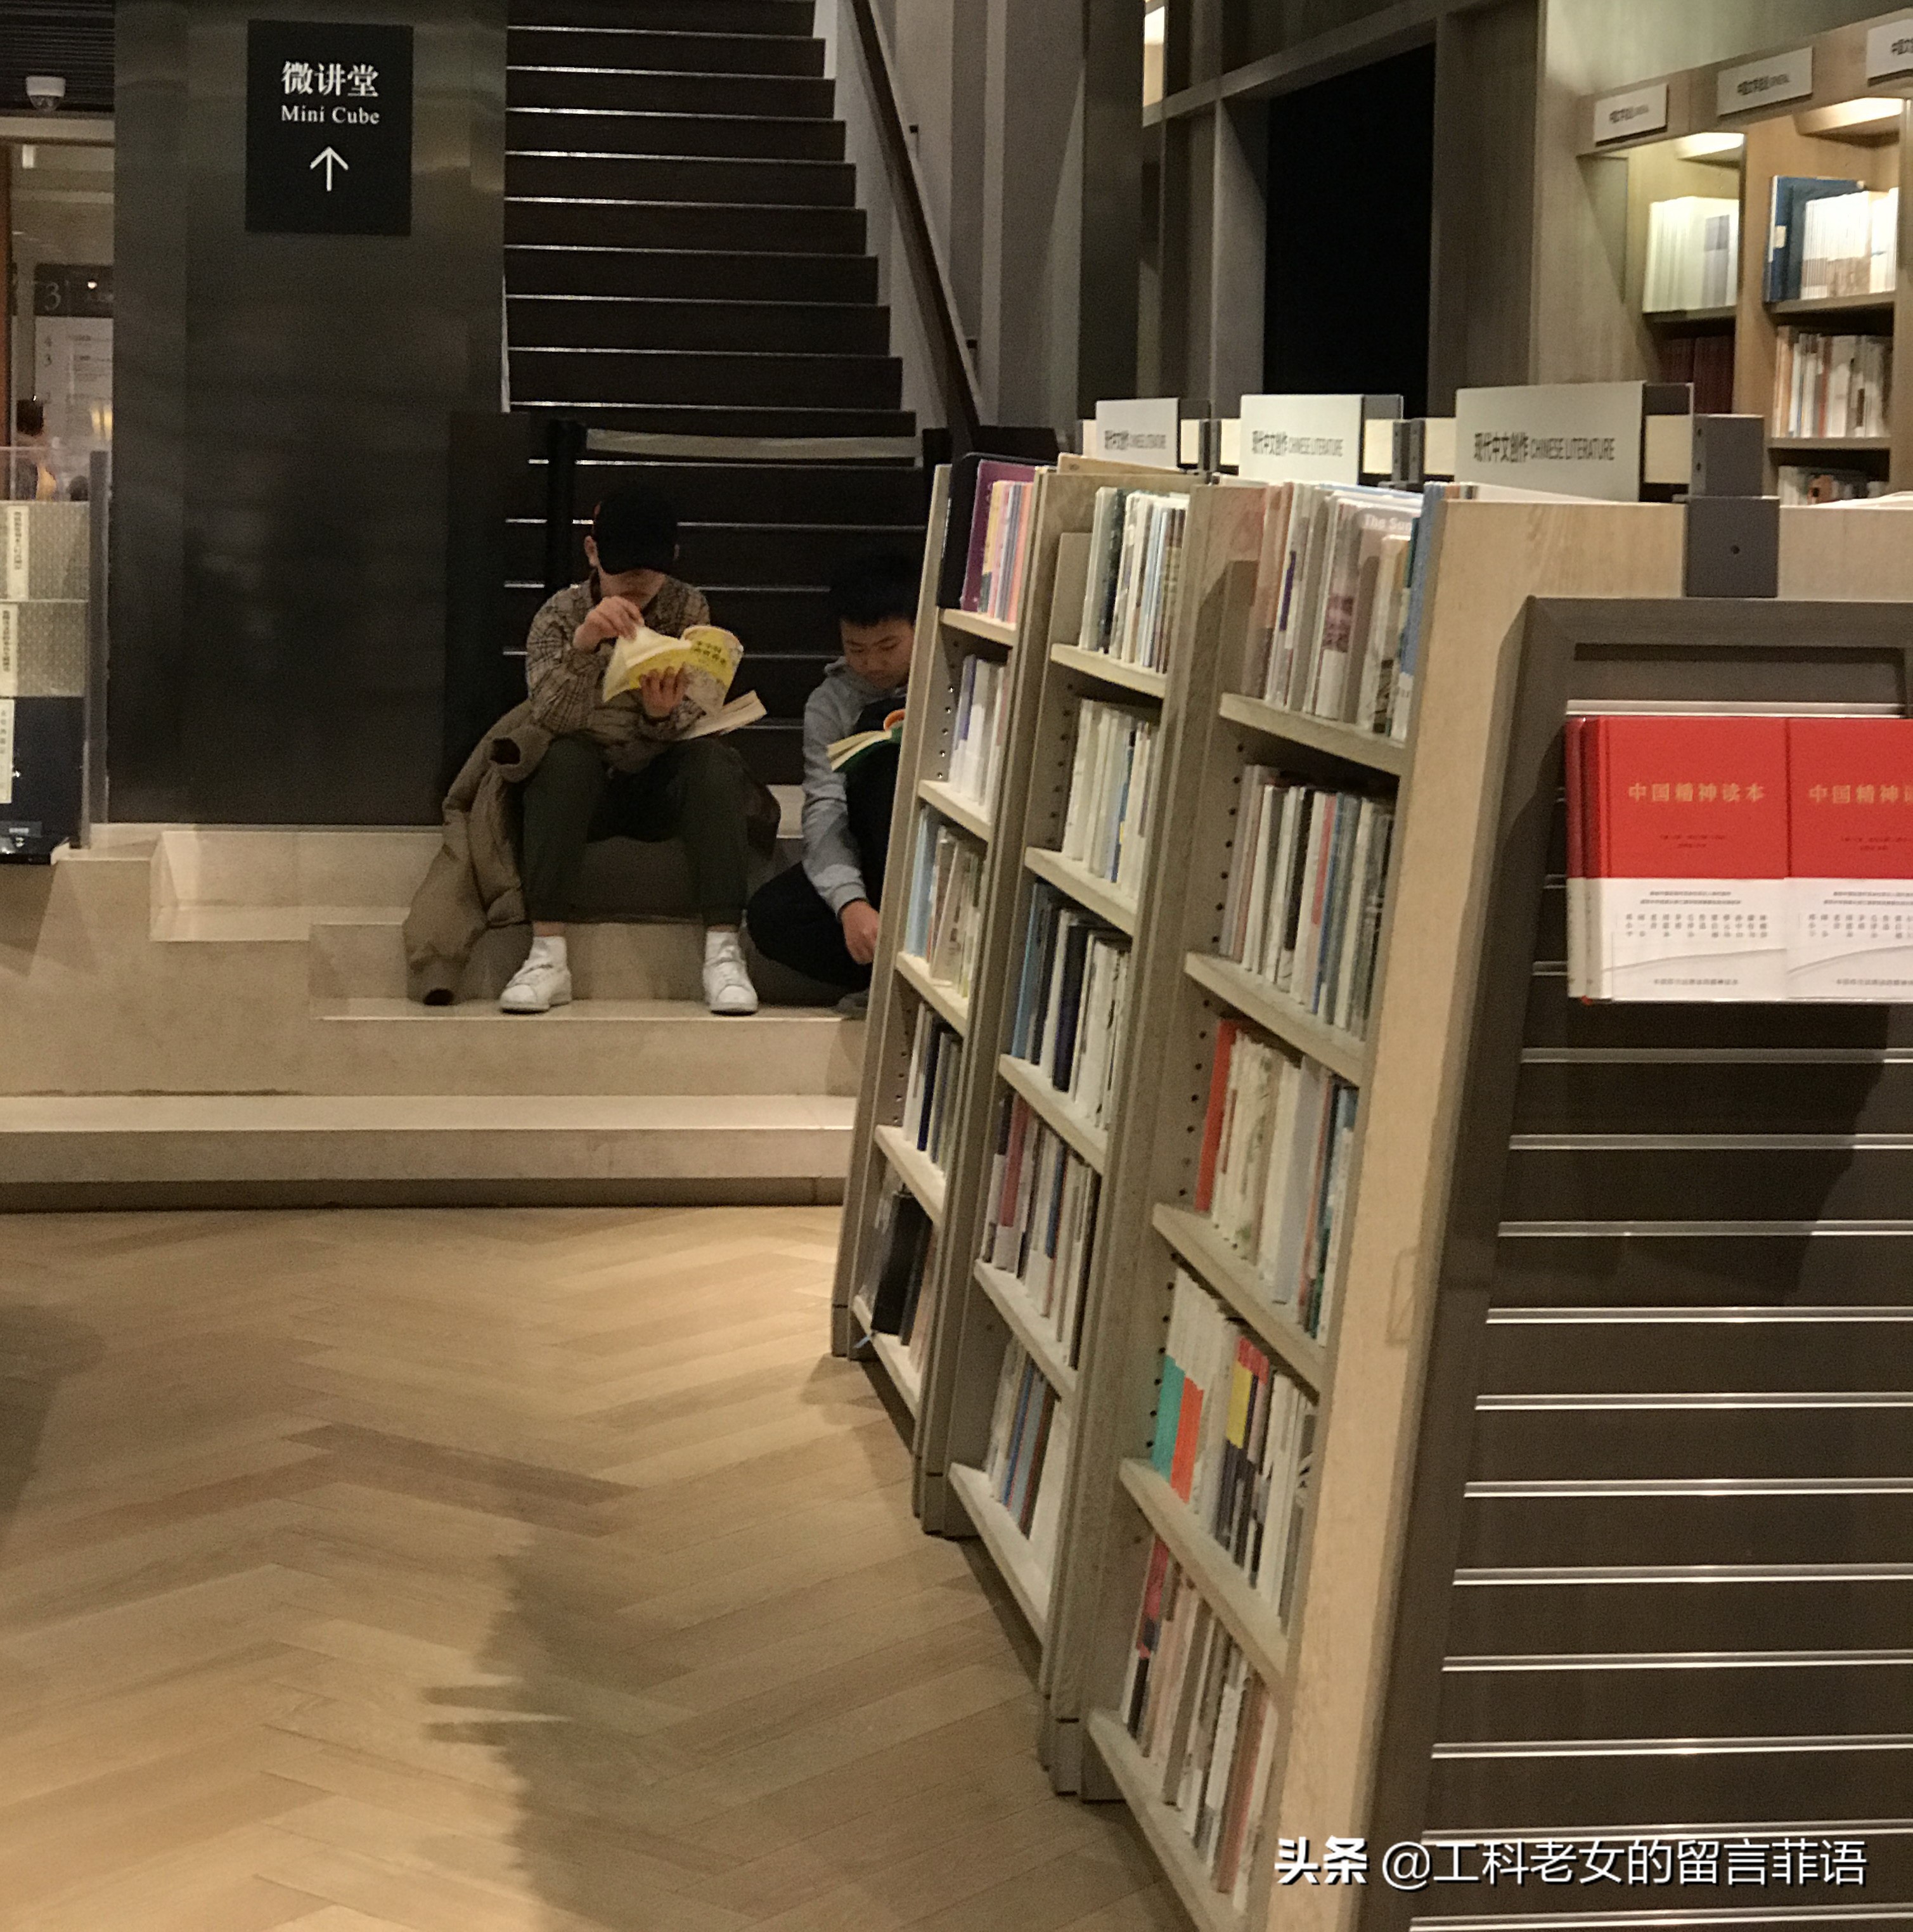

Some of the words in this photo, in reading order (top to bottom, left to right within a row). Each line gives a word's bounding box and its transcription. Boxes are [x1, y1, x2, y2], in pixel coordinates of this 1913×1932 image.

[281, 61, 379, 96] 微讲堂
[281, 104, 325, 123] Mini
[332, 106, 380, 124] Cube
[1474, 432, 1529, 463] 现代中文创作
[1531, 437, 1563, 460] CHINESE
[1566, 437, 1615, 461] LITERATURE
[1628, 782, 1765, 802] 中国精神读本
